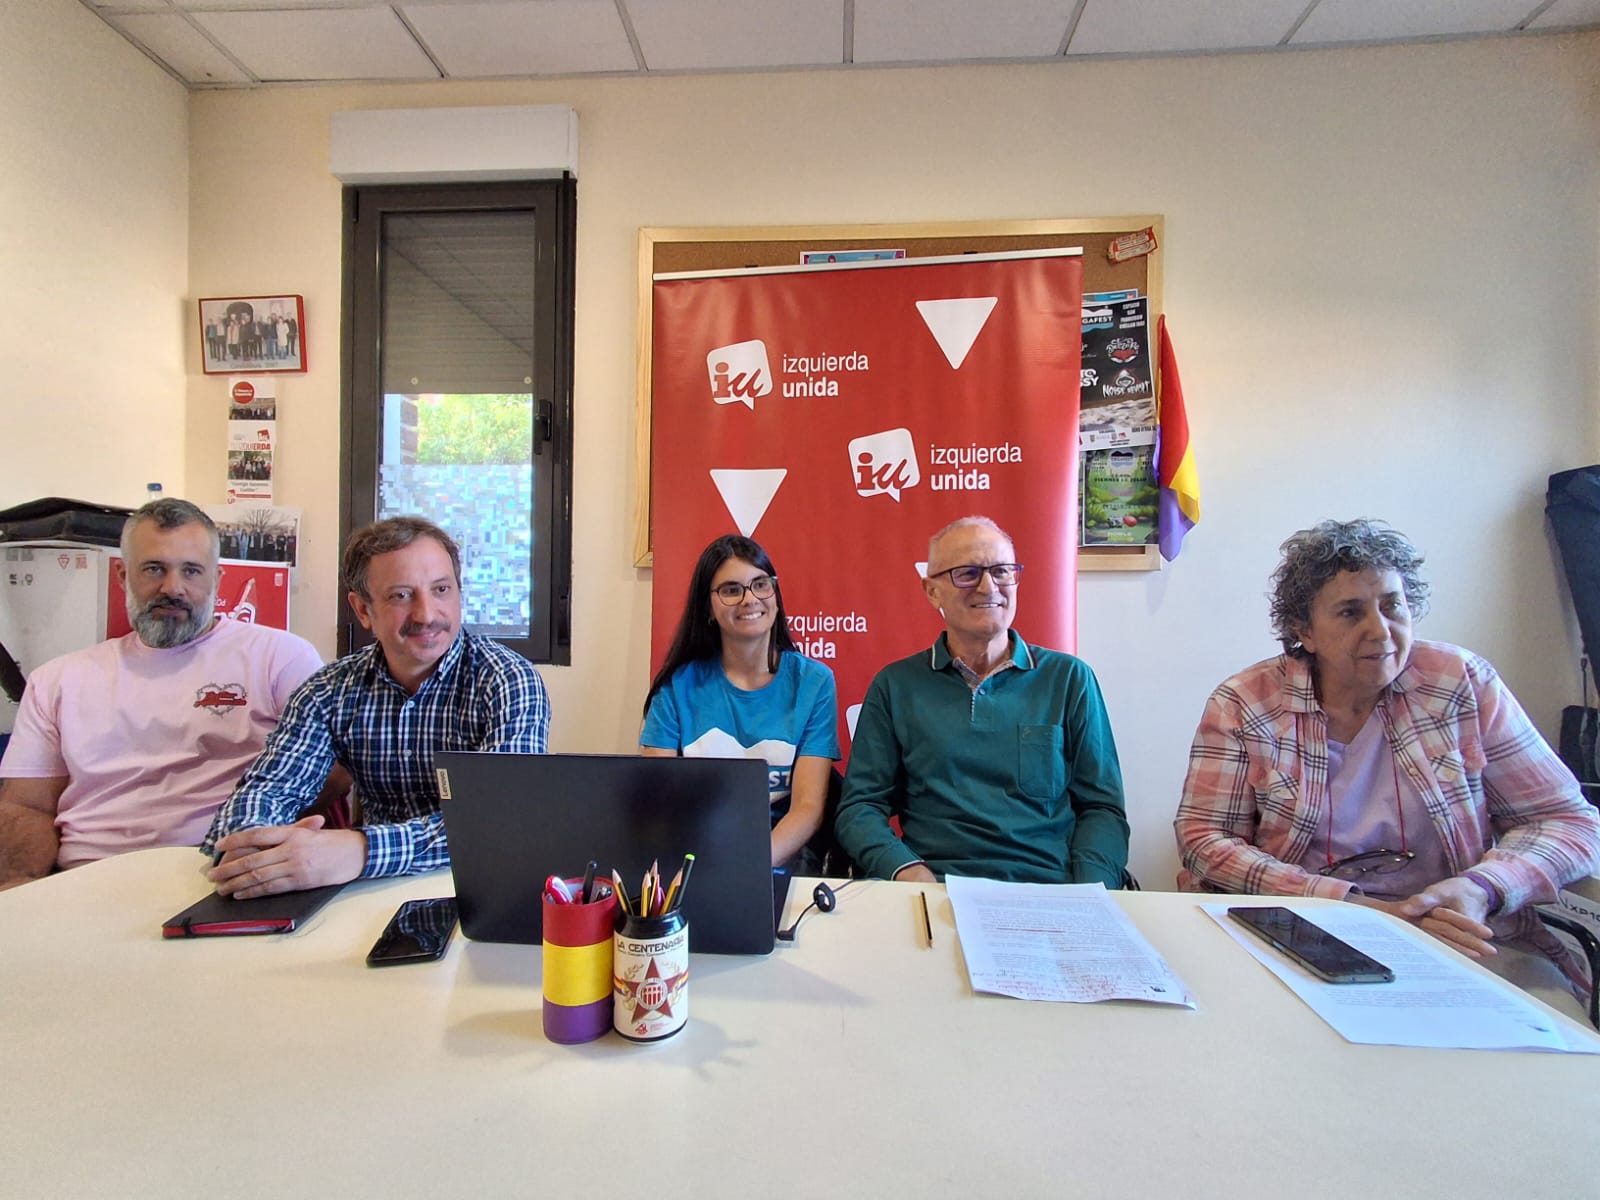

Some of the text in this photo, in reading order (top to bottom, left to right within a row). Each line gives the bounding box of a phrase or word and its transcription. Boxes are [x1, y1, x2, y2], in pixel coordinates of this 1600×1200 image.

[1081, 316, 1113, 324] GAFEST
[782, 351, 870, 377] izquierda
[782, 378, 839, 398] unida
[930, 442, 1023, 470] izquierda
[930, 469, 990, 491] unida
[786, 611, 868, 634] zquierda
[793, 638, 837, 659] nida
